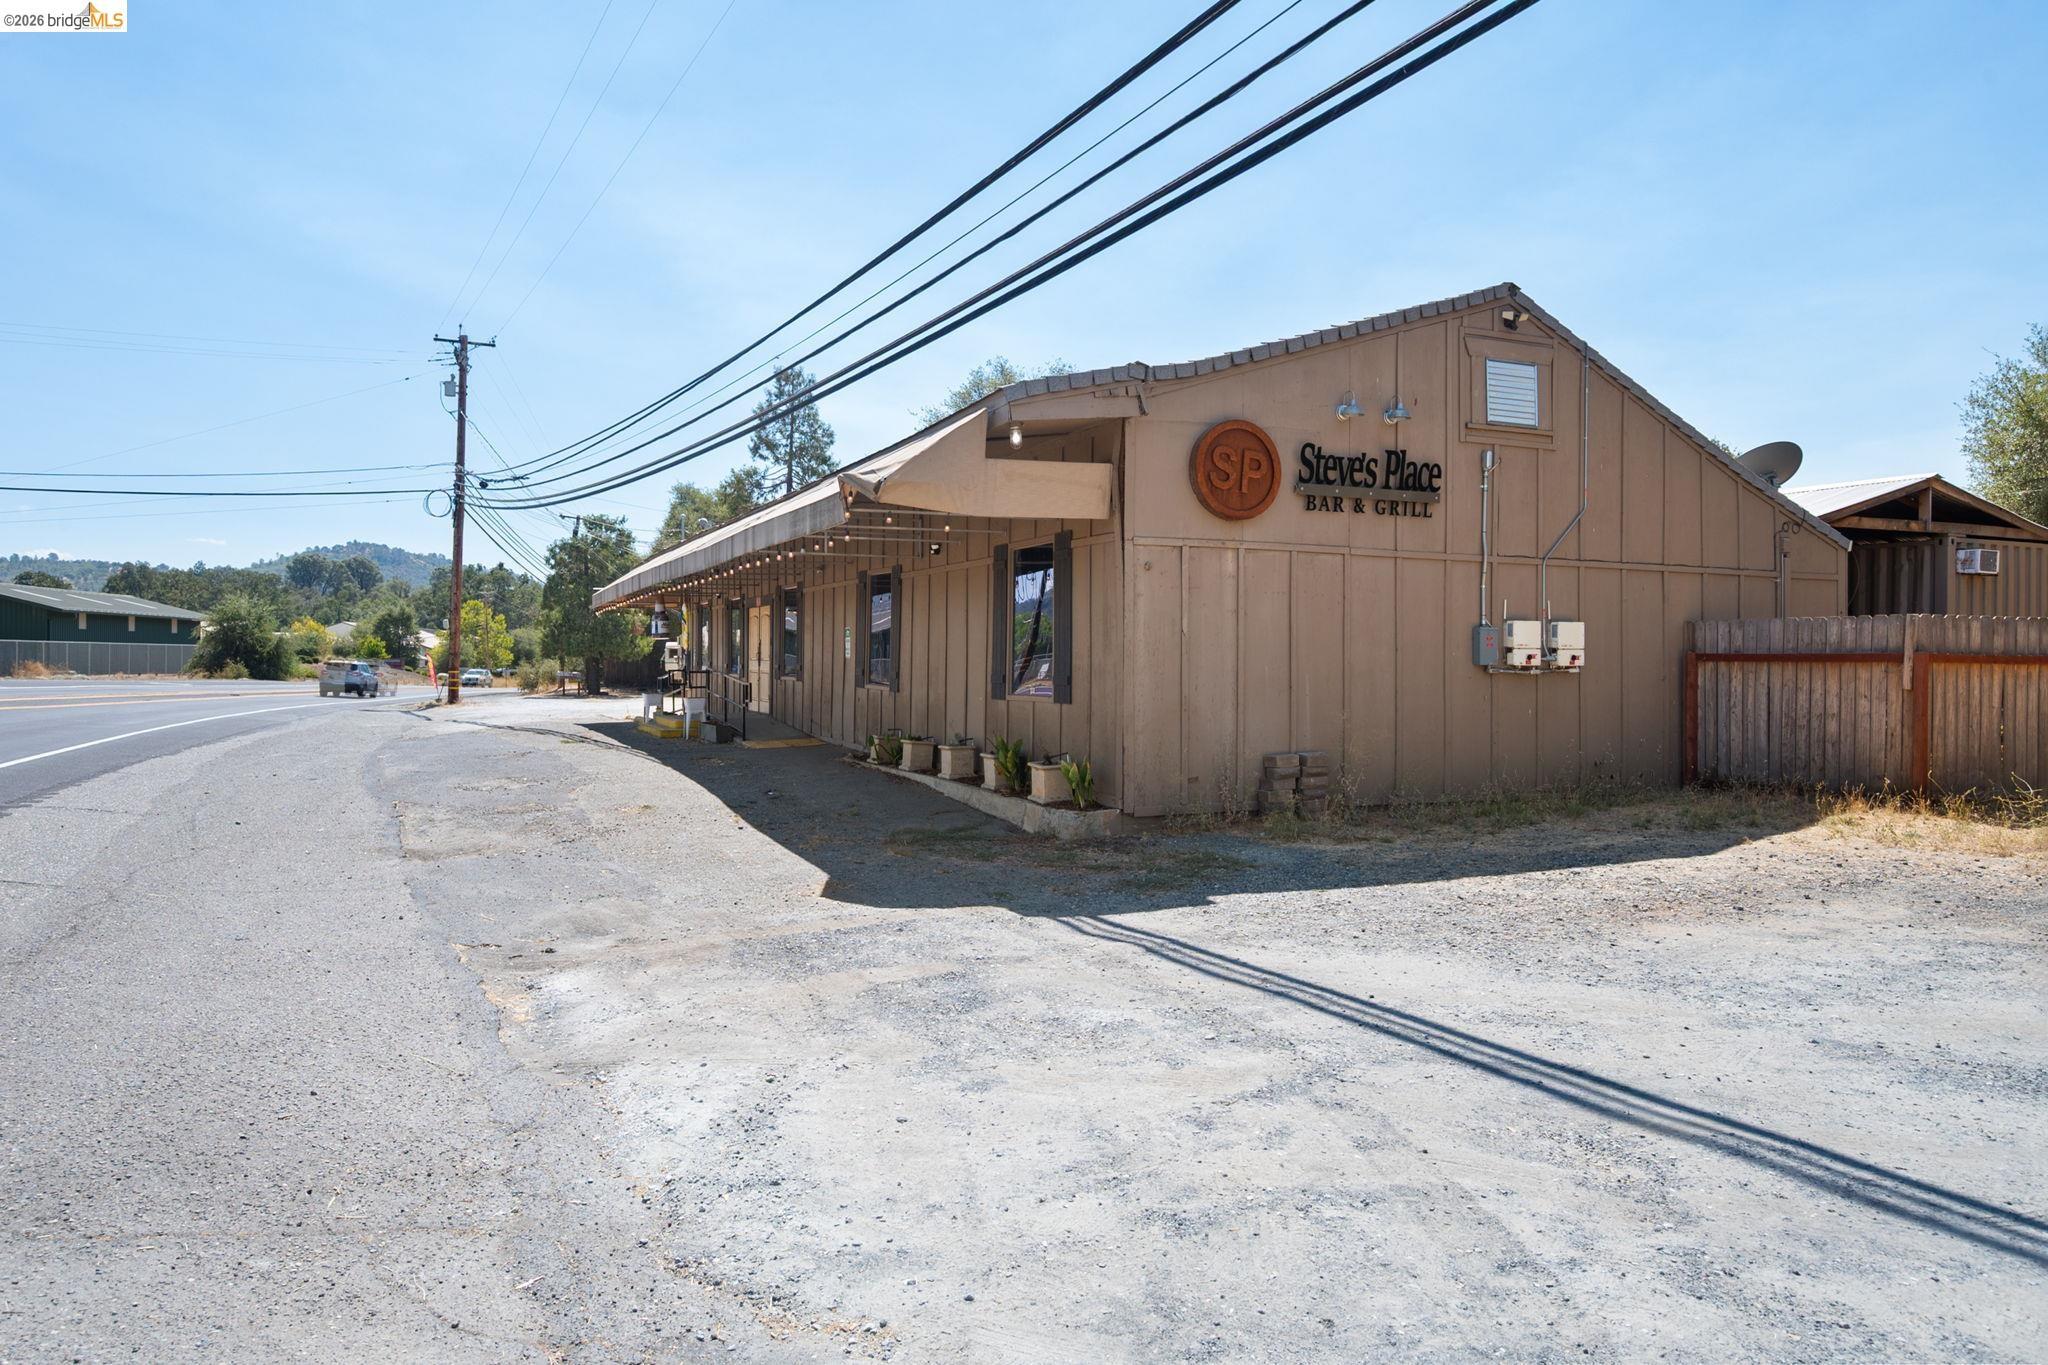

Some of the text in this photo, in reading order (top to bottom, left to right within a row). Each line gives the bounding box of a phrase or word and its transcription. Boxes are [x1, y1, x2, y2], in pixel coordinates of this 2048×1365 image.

[1209, 445, 1268, 494] SP
[1298, 442, 1442, 493] Steve's Place
[1305, 494, 1433, 519] BAR & GRILL
